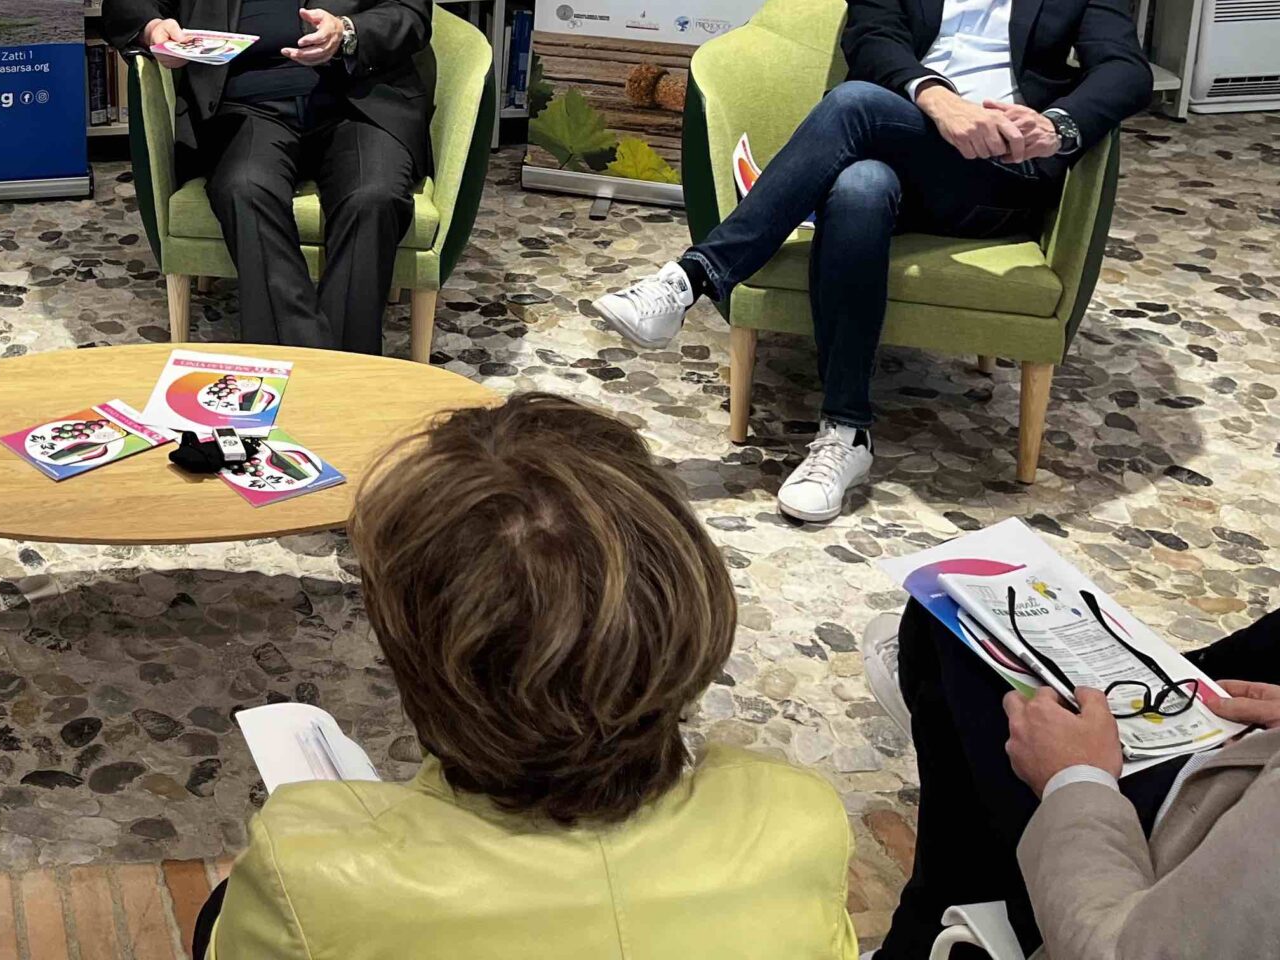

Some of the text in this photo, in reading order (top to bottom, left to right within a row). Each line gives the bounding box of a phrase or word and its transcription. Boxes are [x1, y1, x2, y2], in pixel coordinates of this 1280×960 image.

[1, 51, 27, 61] Zatti
[29, 50, 34, 60] 1
[992, 607, 1050, 618] CENENARIO
